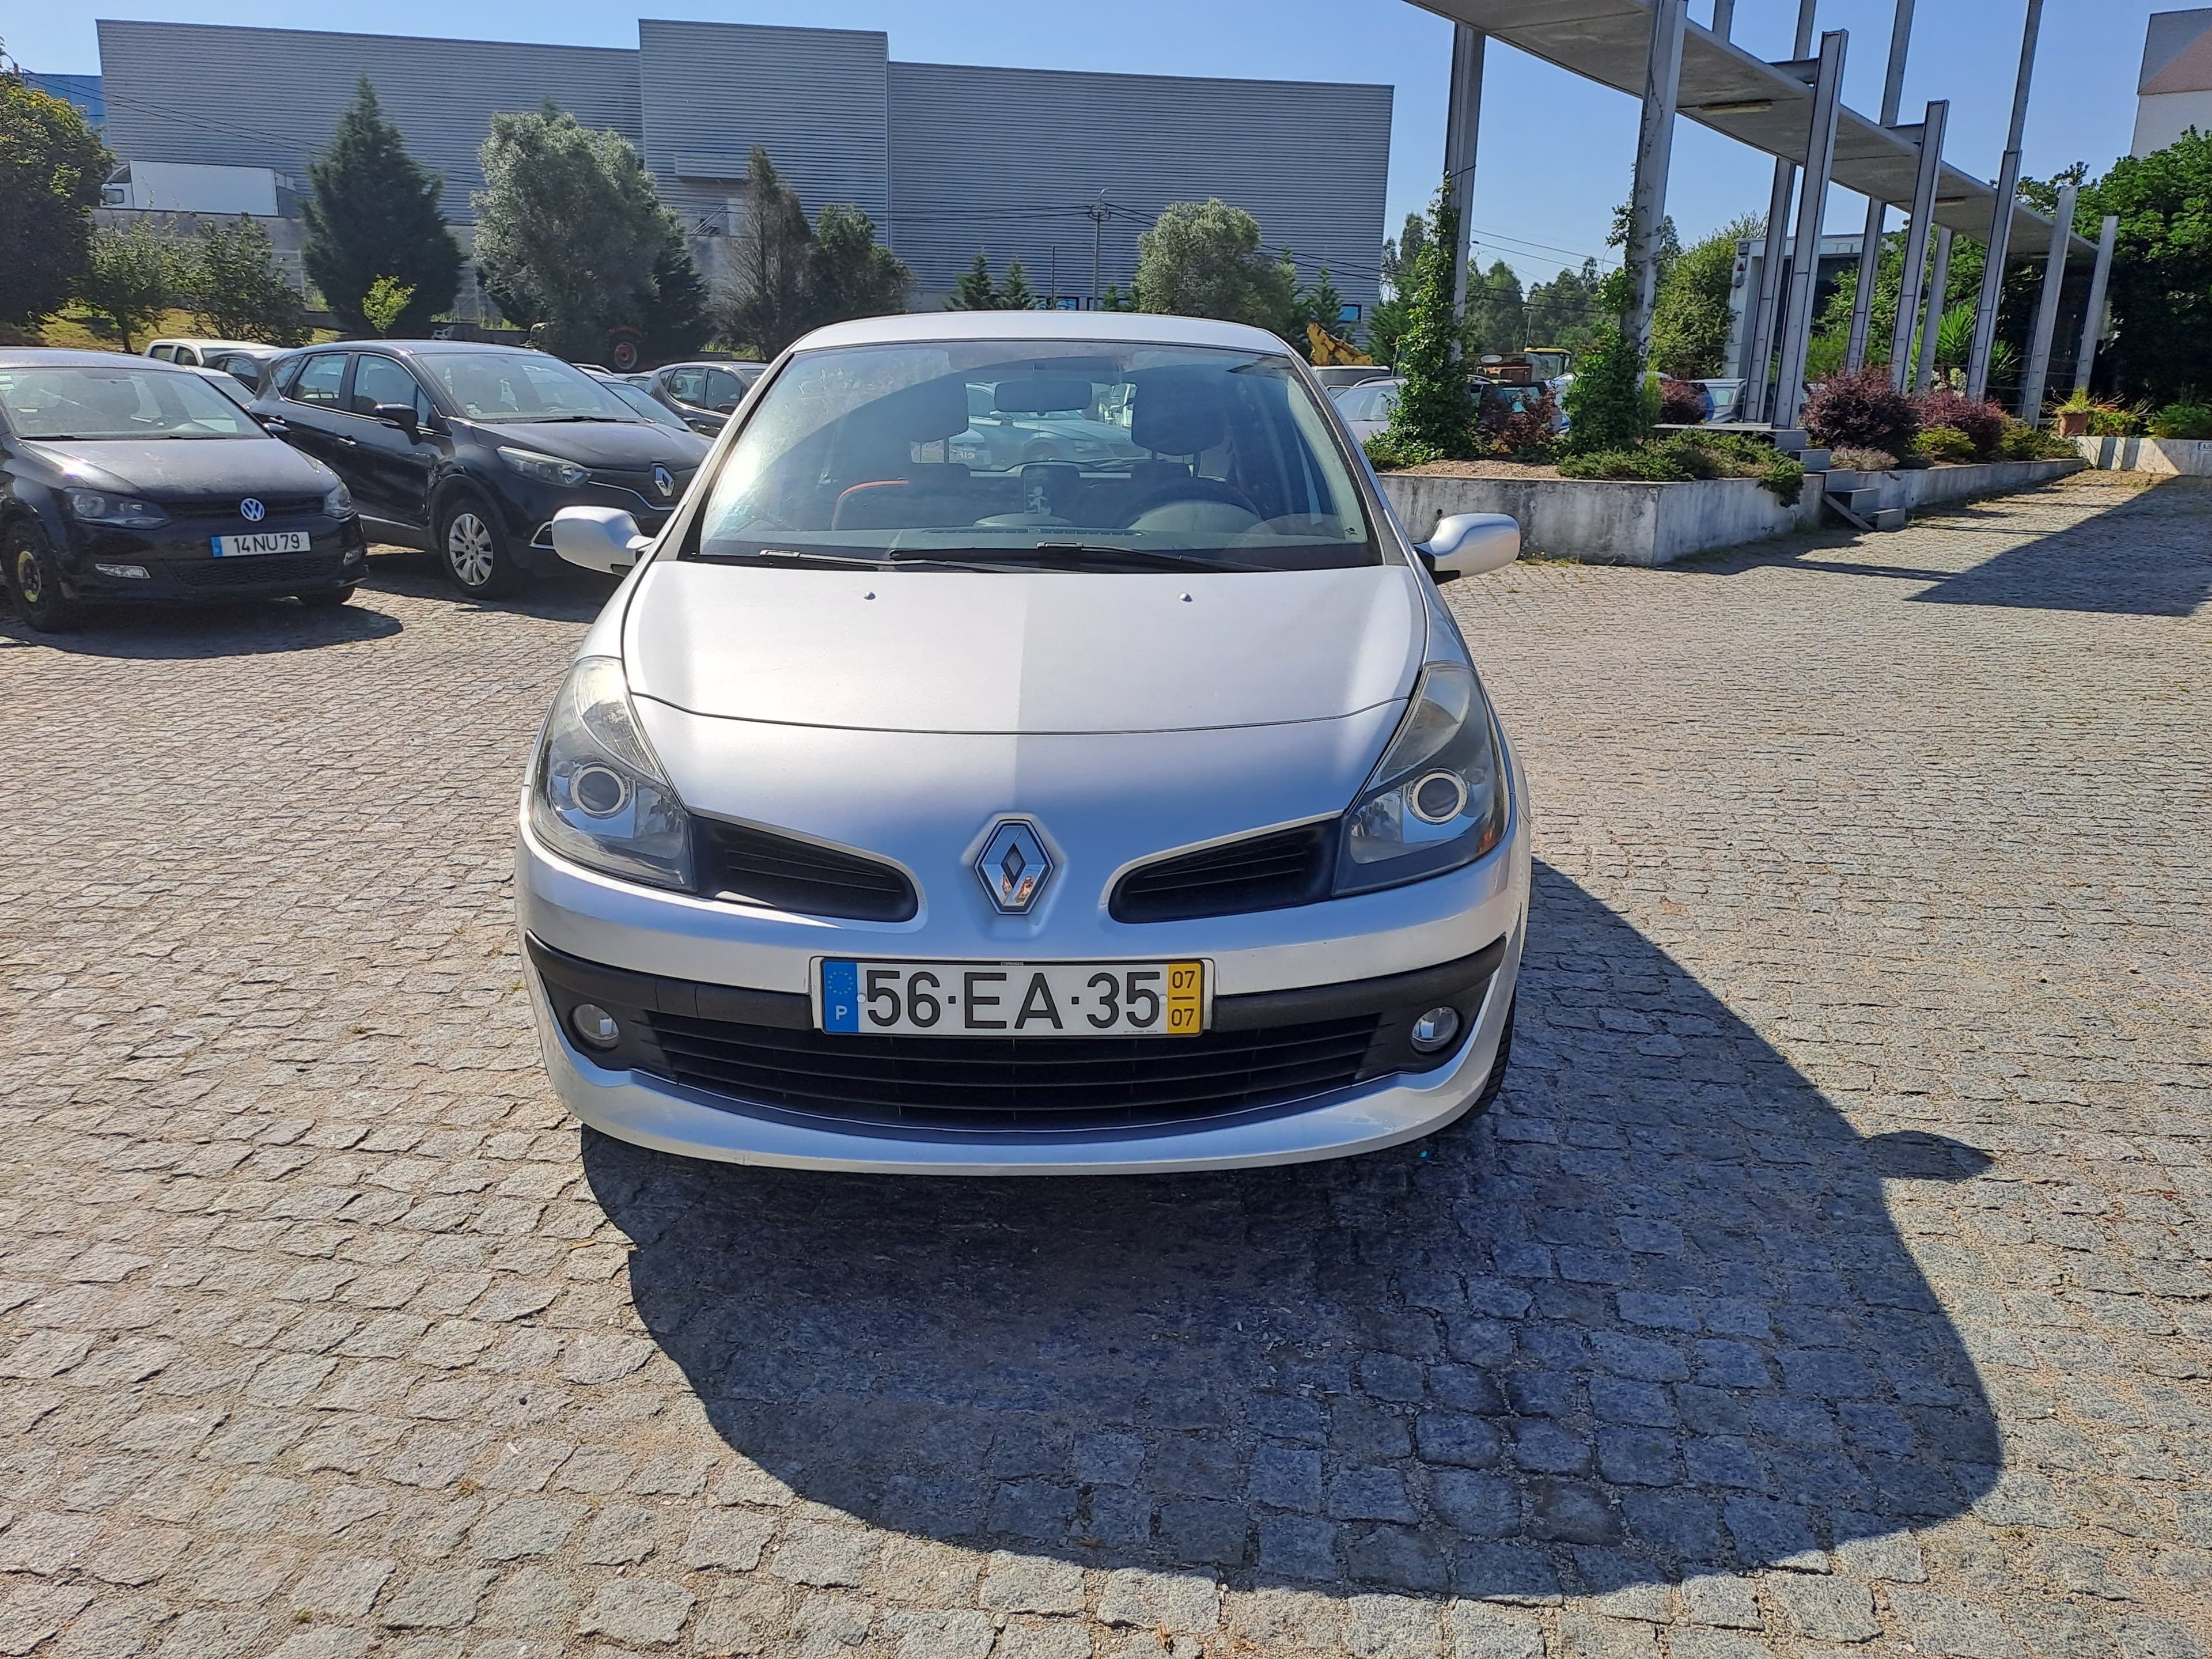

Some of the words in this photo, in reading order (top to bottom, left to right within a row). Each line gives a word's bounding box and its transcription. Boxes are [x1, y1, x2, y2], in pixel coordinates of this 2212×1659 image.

[1172, 970, 1196, 989] 07
[835, 1005, 848, 1020] P
[1171, 1007, 1195, 1027] 07
